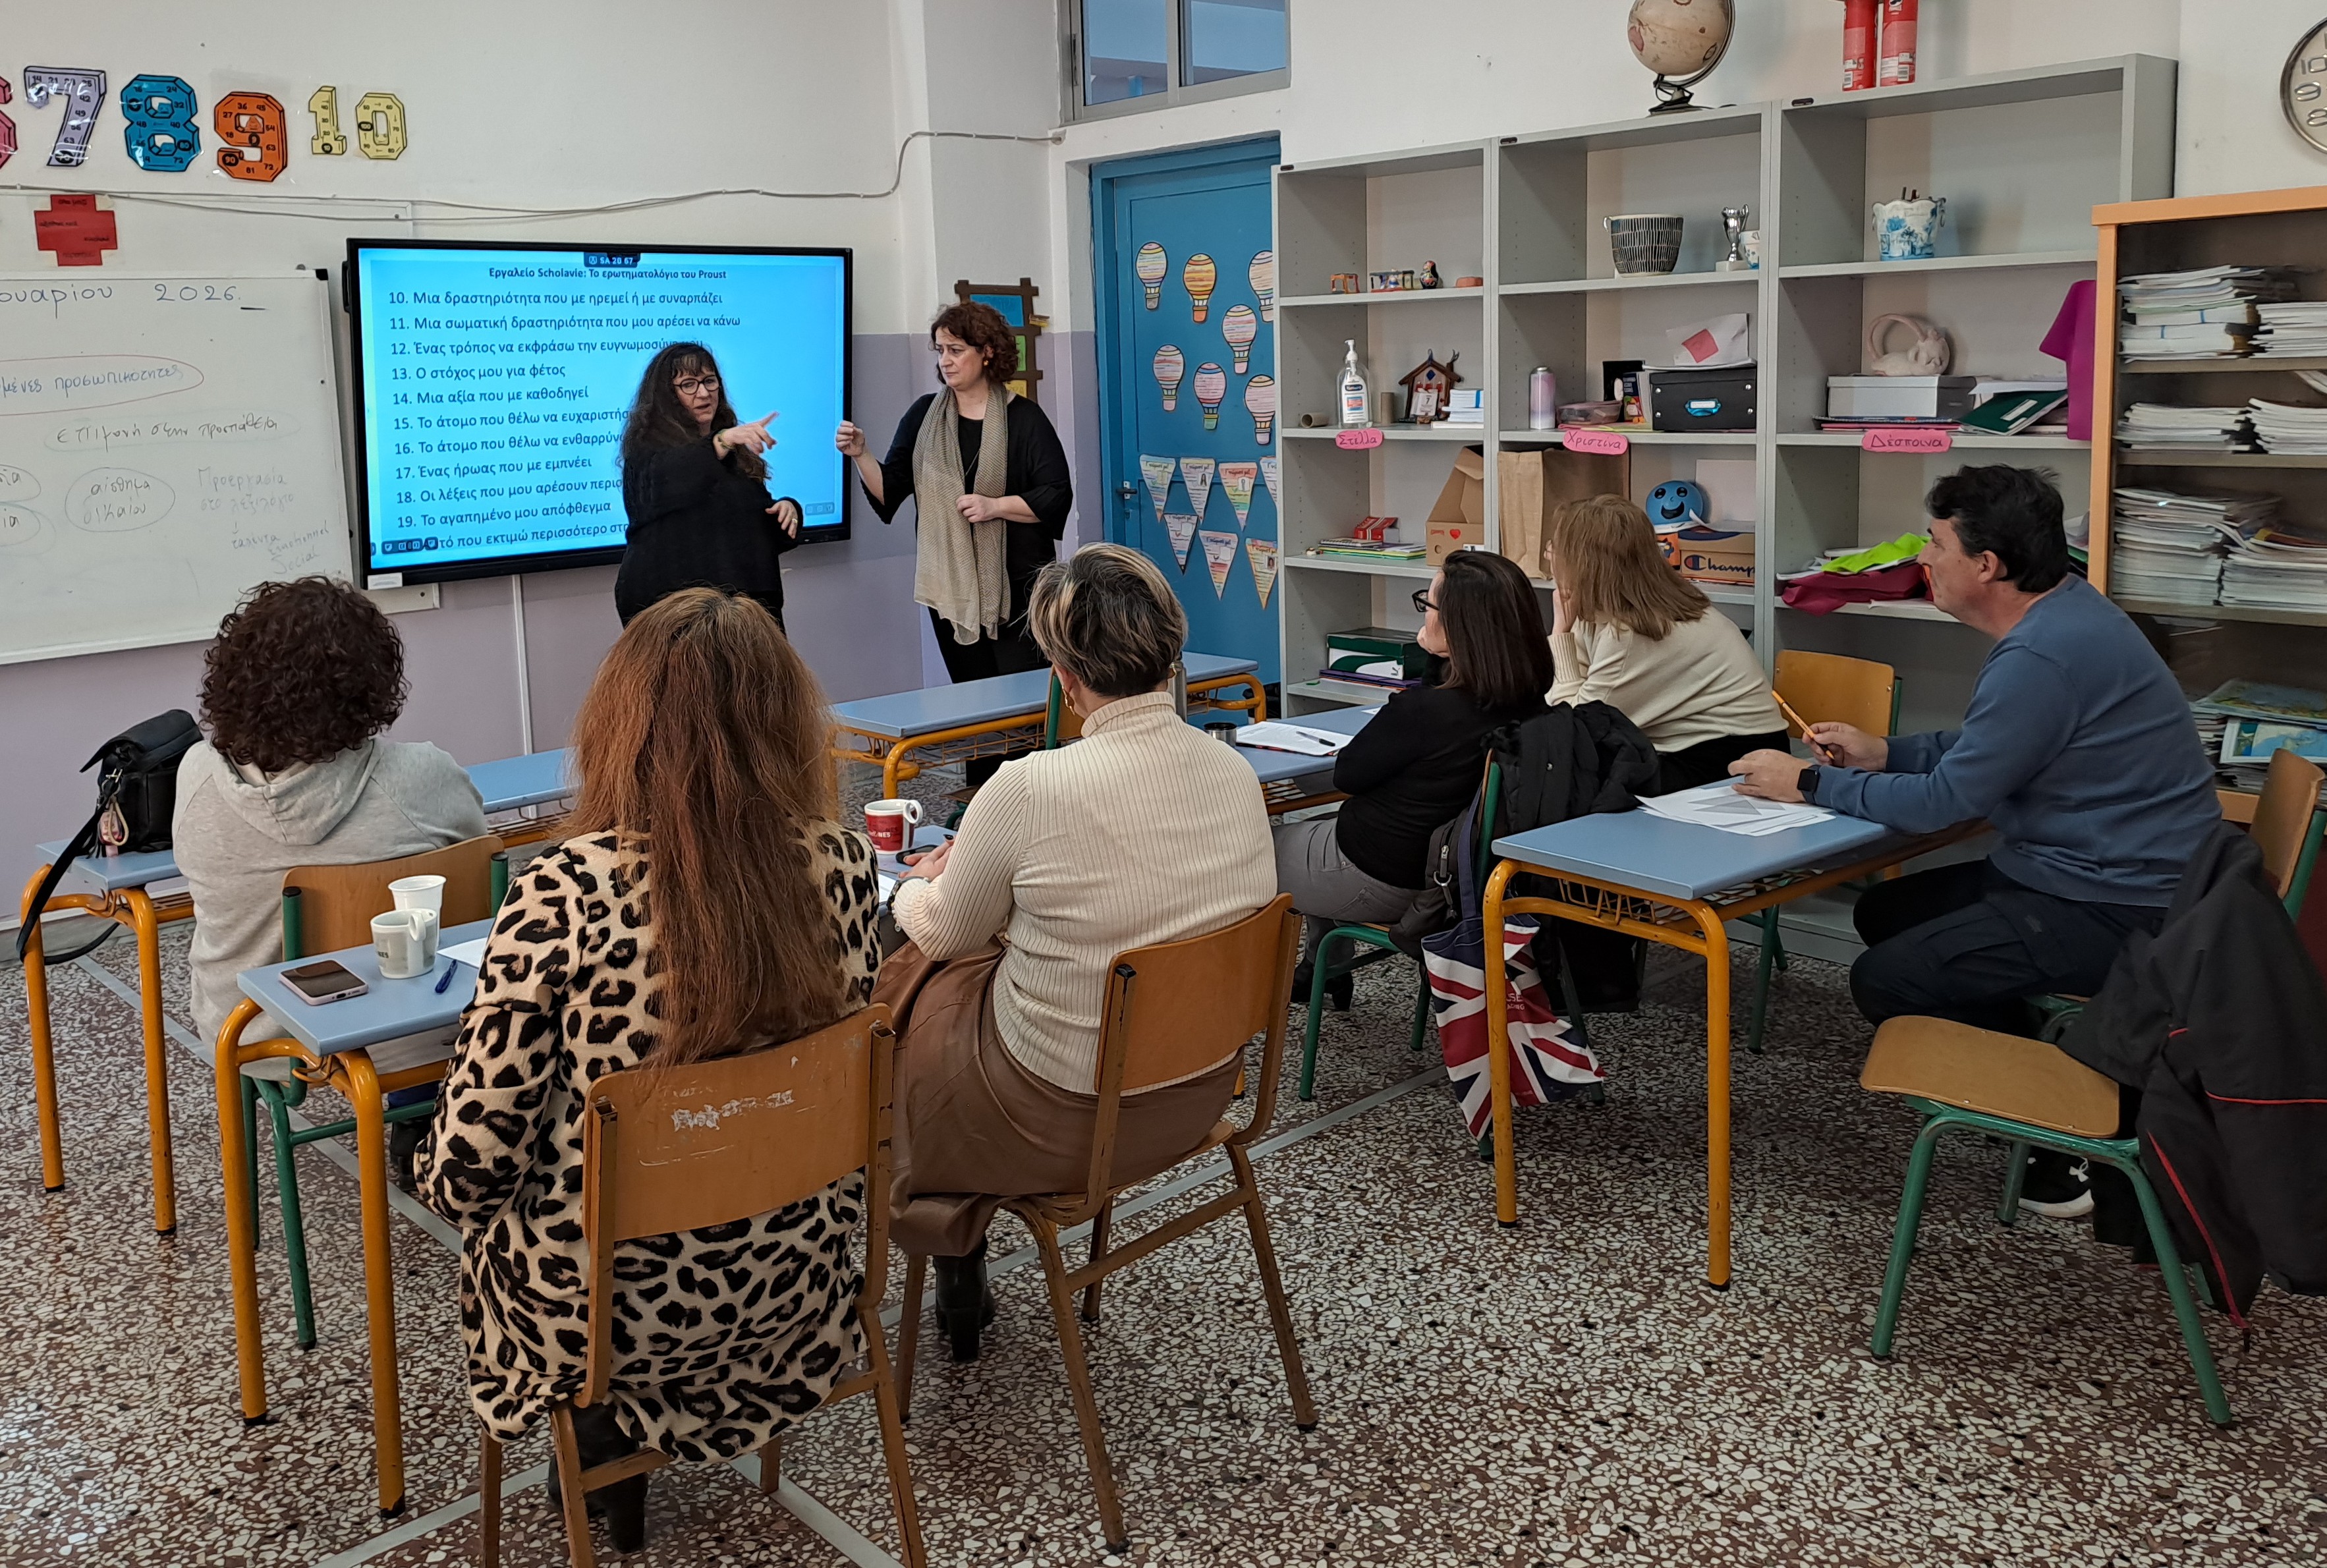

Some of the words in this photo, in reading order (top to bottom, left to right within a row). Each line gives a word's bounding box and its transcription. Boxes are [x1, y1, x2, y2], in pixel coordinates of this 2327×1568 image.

[2294, 82, 2321, 102] 9
[489, 267, 535, 279] Εργαλείο
[588, 268, 600, 278] Το
[602, 268, 679, 281] ερωτηματολόγιο
[698, 269, 727, 279] Proust
[389, 291, 408, 304] 10.
[413, 291, 441, 304] Μια
[444, 291, 542, 307] δραστηριότητα
[544, 294, 568, 304] που
[571, 294, 586, 306] με
[589, 291, 629, 306] ηρεμεί
[632, 291, 639, 306] ή
[642, 294, 656, 306] με
[659, 291, 723, 306] συναρπάζει
[389, 317, 410, 330] 11.
[414, 317, 441, 329] Μια
[445, 315, 507, 332] σωματική
[511, 315, 604, 331] δραστηριότητα
[605, 318, 628, 327] που
[632, 318, 654, 330] μου
[657, 314, 695, 329] αρέσει
[696, 318, 711, 326] να
[713, 314, 741, 326] κάνω
[391, 343, 410, 355] 12.
[413, 341, 446, 356] Ένας
[449, 341, 496, 356] τρόπος
[498, 343, 515, 352] να
[518, 339, 575, 355] εκφράσω
[577, 342, 598, 354] την
[600, 337, 678, 353] ευγνωμοσύν
[391, 368, 411, 380] 13.
[416, 367, 426, 379] Ο
[430, 365, 476, 381] στόχος
[478, 368, 503, 380] μου
[506, 367, 526, 379] για
[529, 363, 566, 379] φέτος
[393, 393, 412, 405] 14.
[417, 391, 444, 404] Μια
[447, 389, 476, 405] αξία
[479, 392, 503, 402] που
[507, 391, 522, 403] με
[526, 385, 589, 401] καθοδηγεί
[394, 417, 413, 430] 15.
[417, 416, 432, 429] Το
[436, 414, 477, 430] άτομο
[479, 416, 505, 426] που
[508, 411, 540, 424] θέλω
[543, 413, 559, 422] να
[561, 407, 629, 424] ευχαριστήσ
[395, 442, 414, 455] 16.
[418, 441, 434, 453] Το
[437, 439, 478, 454] άτομο
[480, 439, 505, 450] που
[508, 435, 540, 449] θέλω
[543, 437, 559, 446] να
[1567, 430, 1621, 449] Χριστίνα
[1870, 434, 1943, 448] Δέσποινα
[396, 466, 415, 480] 17.
[418, 465, 450, 479] Ένας
[454, 462, 496, 478] ήρωας
[499, 462, 523, 473] που
[527, 461, 542, 474] με
[545, 455, 592, 472] εμπνέει
[397, 491, 416, 504] 18.
[420, 490, 436, 502] Οι
[438, 487, 477, 502] λέξεις
[480, 487, 505, 498] που
[509, 486, 532, 499] μου
[536, 480, 588, 496] αρέσουν
[590, 479, 622, 491] περισ
[397, 515, 416, 528] 19.
[420, 514, 435, 526] Το
[439, 507, 511, 526] αγαπημένο
[515, 508, 538, 521] μου
[542, 501, 611, 517] απόφθεγμα
[457, 536, 482, 547] που
[486, 528, 528, 545] εκτιμώ
[531, 524, 607, 542] περισσότερο
[1683, 554, 1754, 578] Champ
